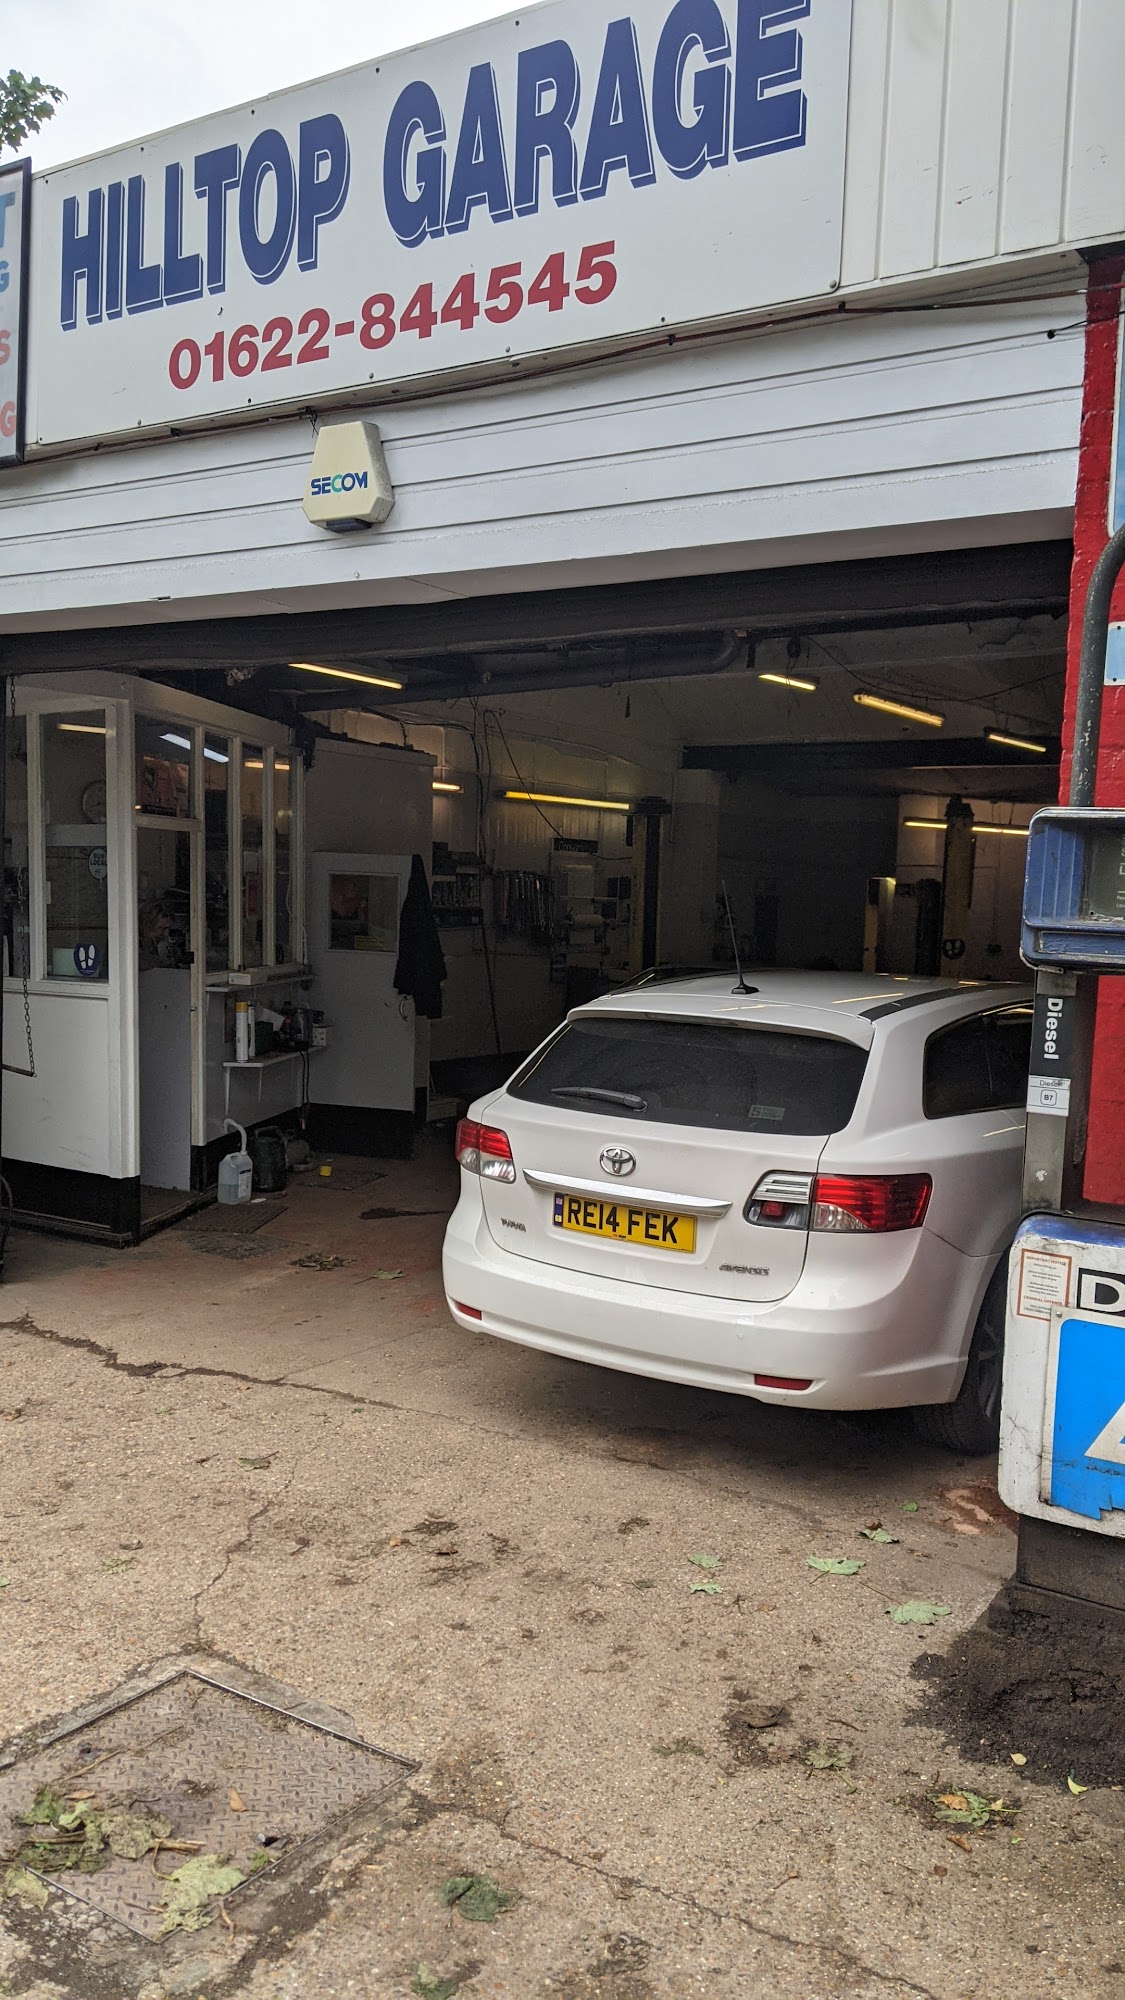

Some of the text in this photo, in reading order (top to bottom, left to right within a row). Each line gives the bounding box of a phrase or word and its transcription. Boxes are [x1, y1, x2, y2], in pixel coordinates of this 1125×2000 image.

[61, 0, 810, 331] HILLTOP GARAGE
[169, 240, 617, 390] 01622-844545
[310, 471, 368, 496] SECOM
[1043, 997, 1064, 1060] Diesel
[567, 1198, 680, 1244] RE14 FEK
